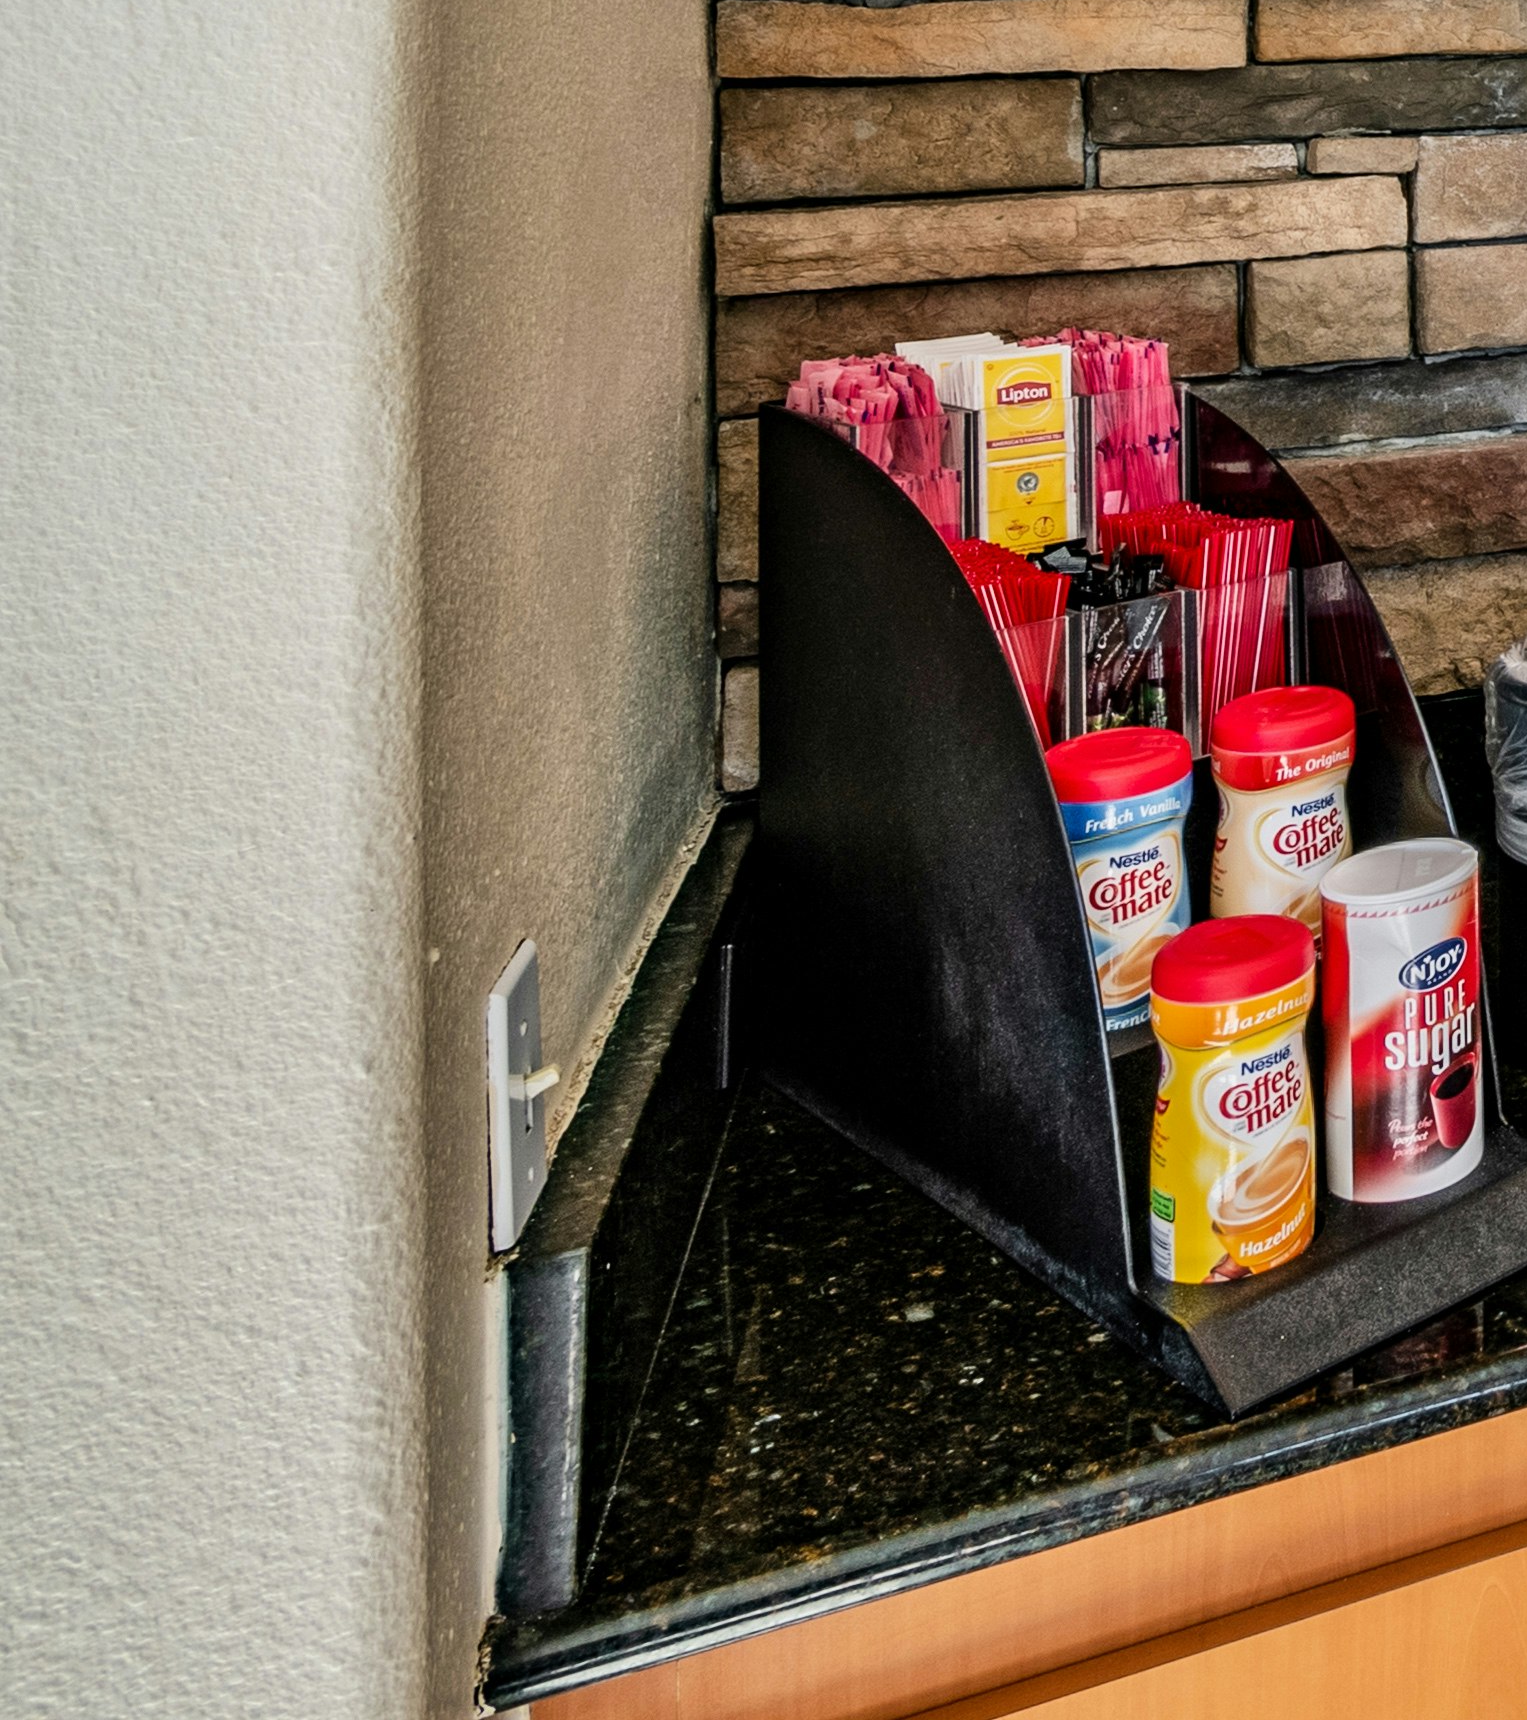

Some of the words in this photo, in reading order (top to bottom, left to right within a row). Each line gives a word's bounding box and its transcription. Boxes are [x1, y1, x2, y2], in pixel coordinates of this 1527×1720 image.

[1001, 386, 1049, 403] Lipton
[1276, 766, 1301, 782] The
[1305, 747, 1350, 772] Original
[1139, 797, 1181, 817] Vanilla
[1296, 823, 1344, 868] mate
[1112, 878, 1174, 925] mate
[1222, 991, 1309, 1036] Hazelnut
[1405, 979, 1466, 1030] PURE
[1384, 1001, 1476, 1076] sugar
[1247, 1080, 1302, 1133] mate
[1239, 1202, 1306, 1258] Hazelnut
